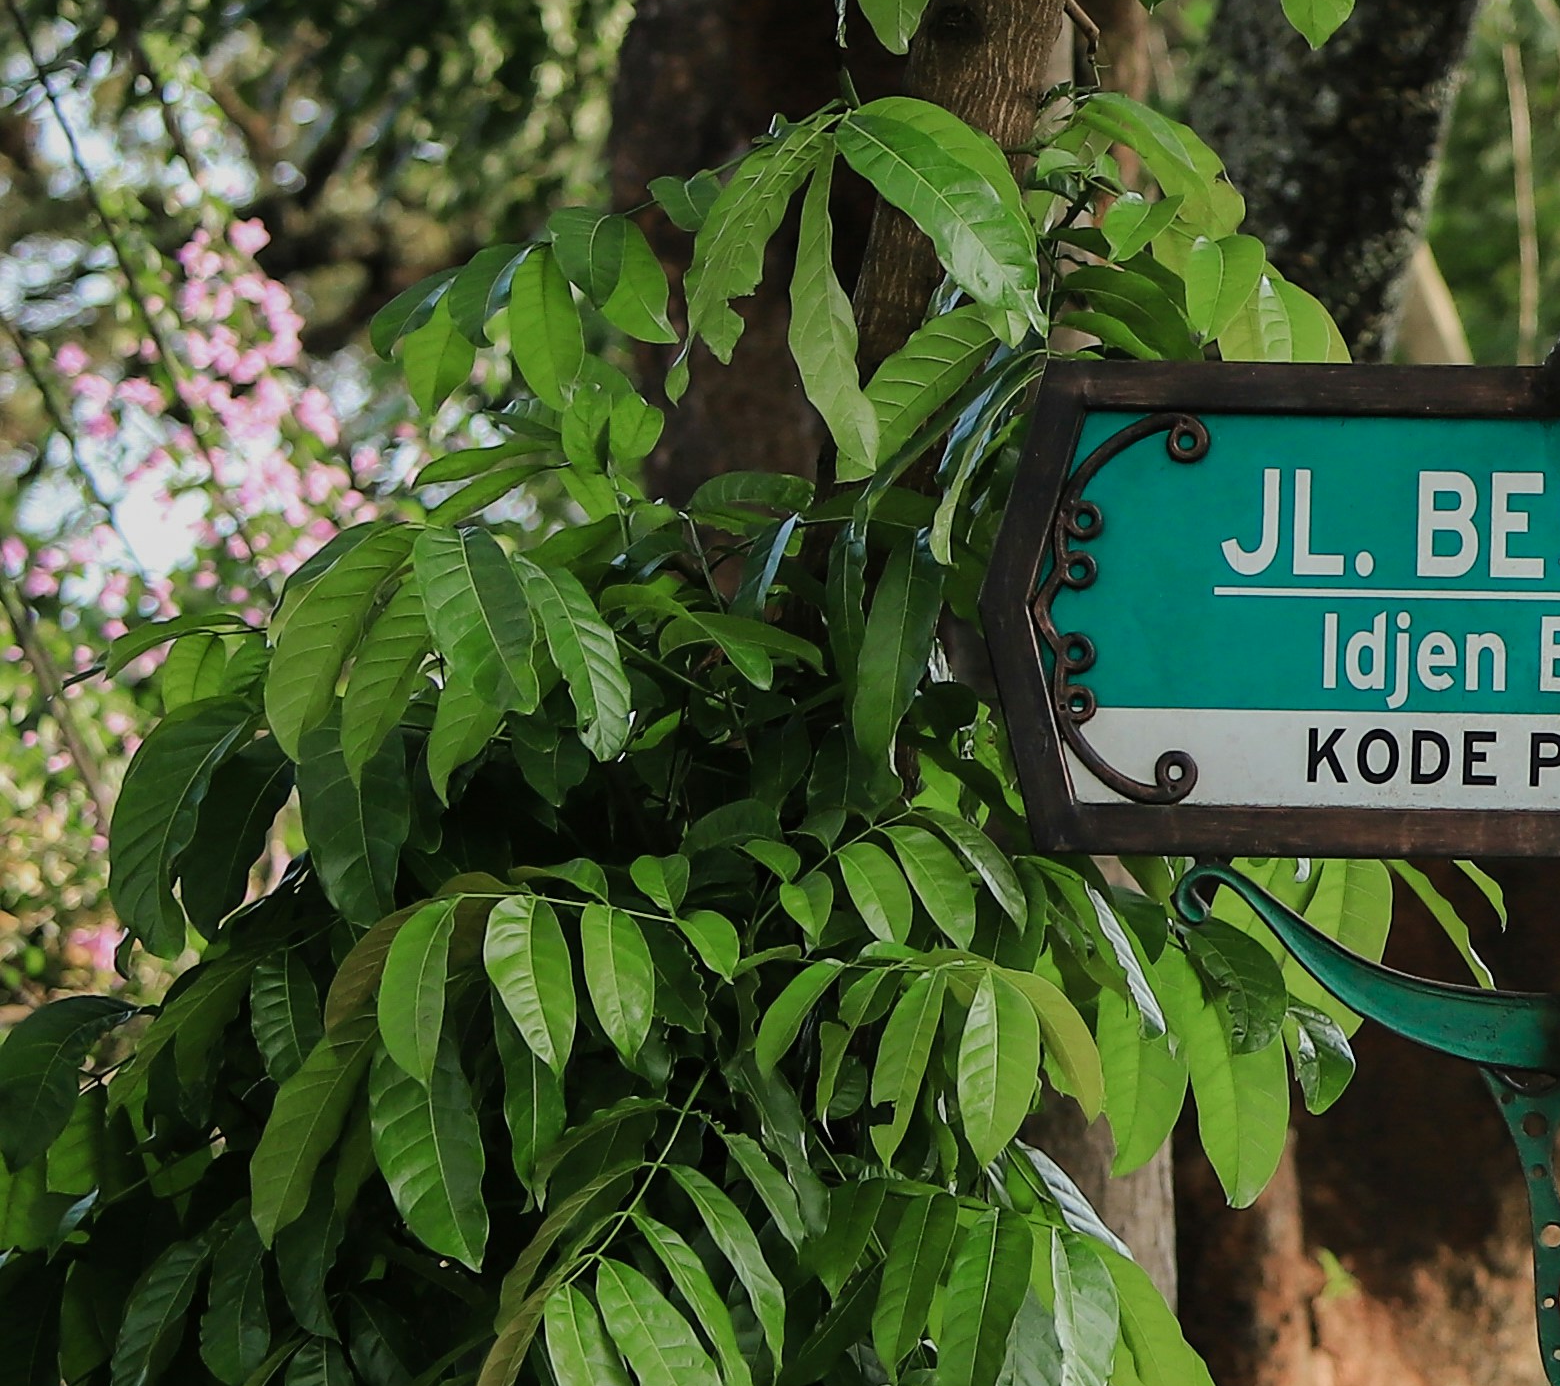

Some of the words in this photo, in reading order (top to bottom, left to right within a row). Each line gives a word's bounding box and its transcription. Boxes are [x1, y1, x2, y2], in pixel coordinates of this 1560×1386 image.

[1220, 467, 1375, 578] JL.
[1322, 610, 1507, 709] Idjen
[1305, 726, 1498, 787] KODE
